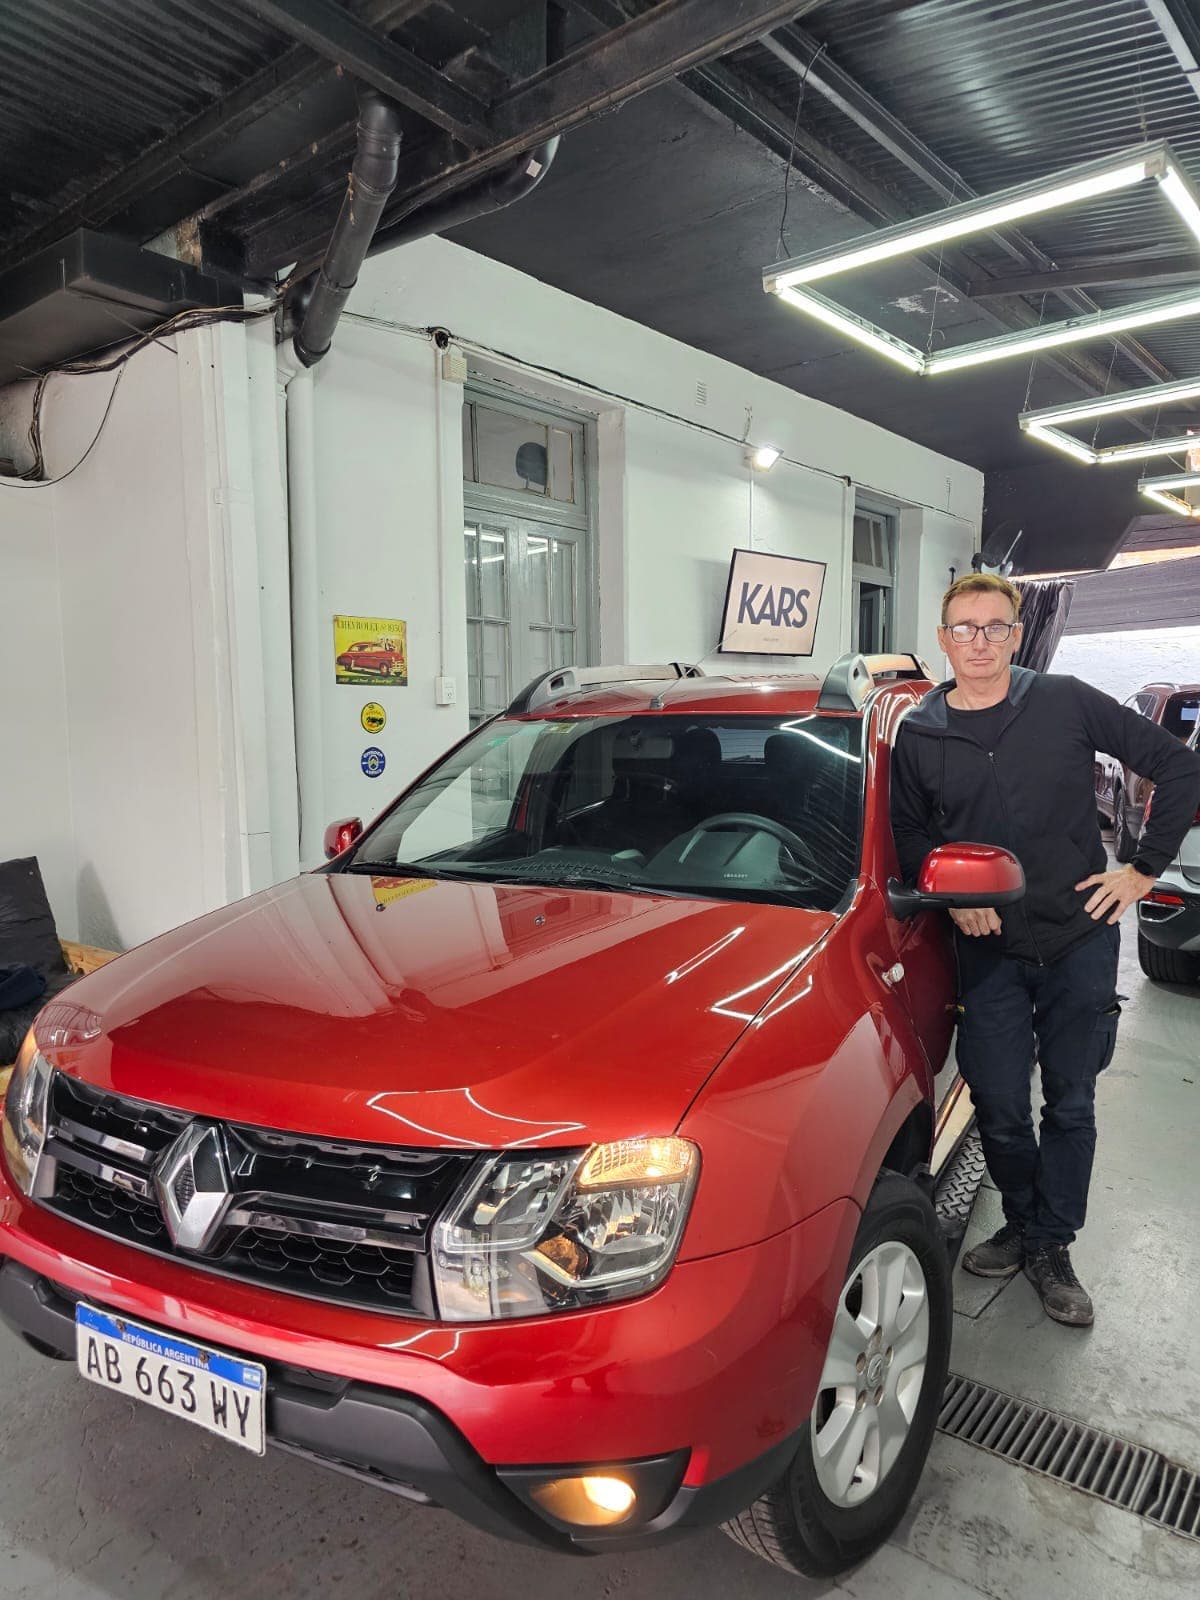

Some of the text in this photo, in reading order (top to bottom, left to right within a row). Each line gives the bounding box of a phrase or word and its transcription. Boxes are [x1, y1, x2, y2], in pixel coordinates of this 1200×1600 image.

[737, 582, 811, 629] KARS
[122, 1332, 163, 1354] REPÚBLICA
[87, 1335, 251, 1438] AB 663 WY
